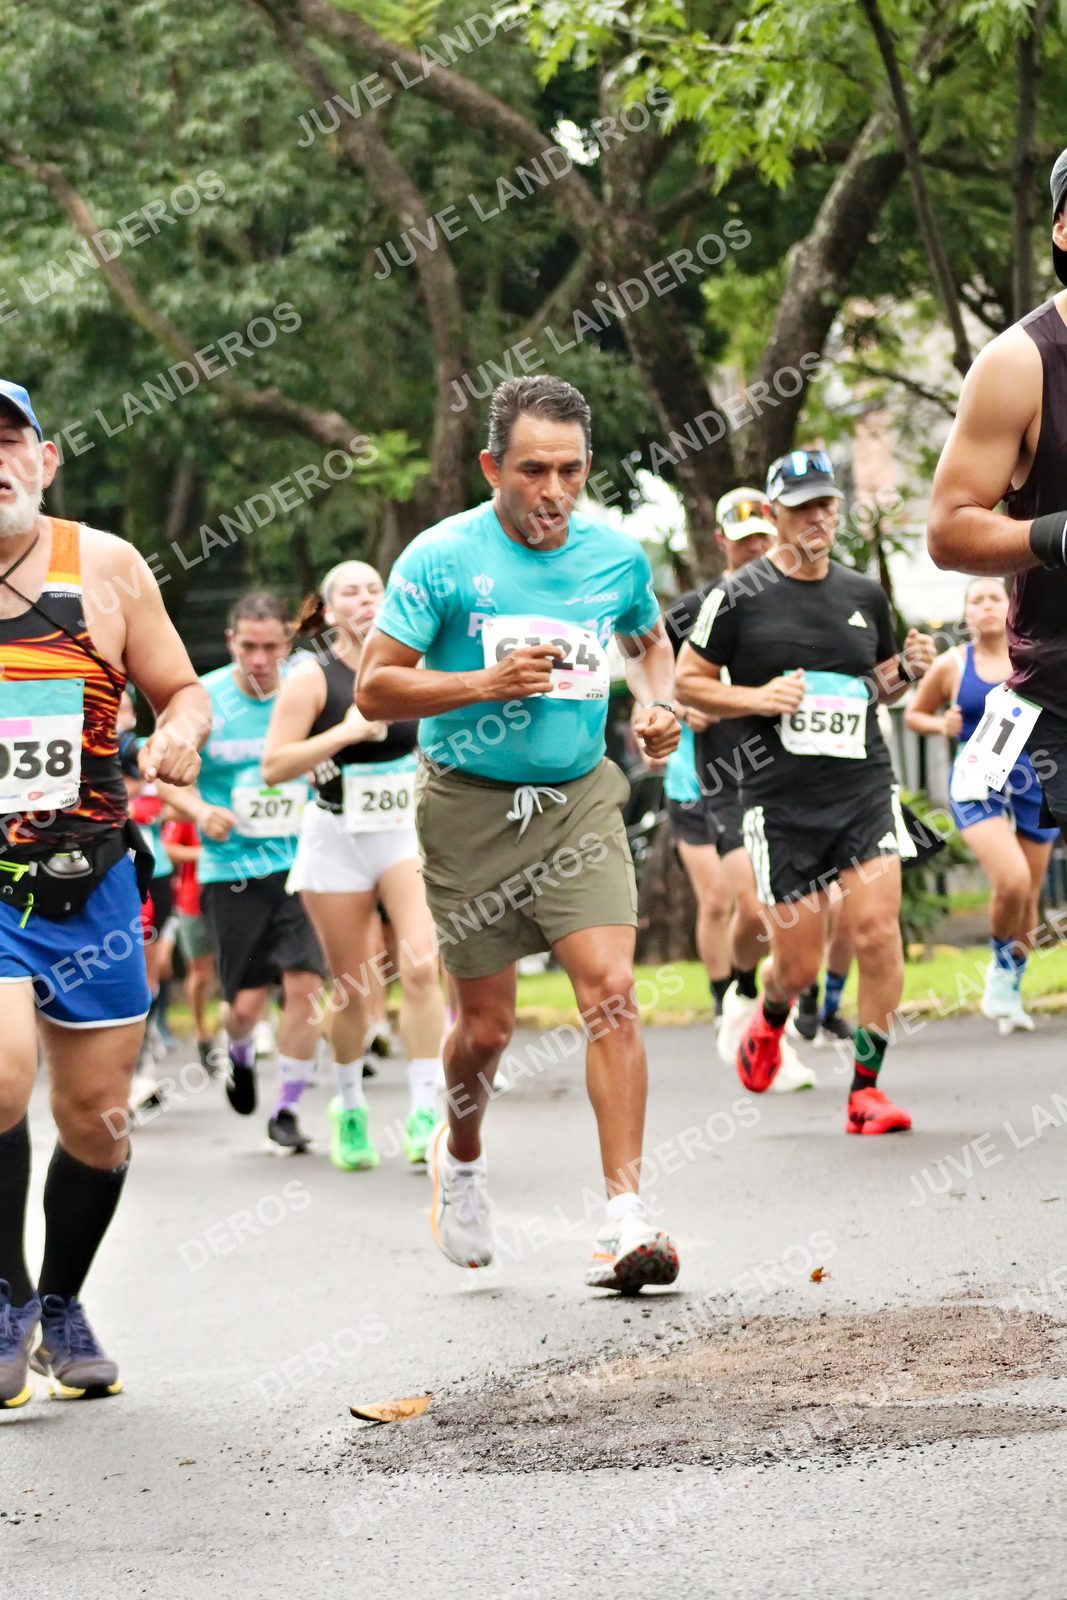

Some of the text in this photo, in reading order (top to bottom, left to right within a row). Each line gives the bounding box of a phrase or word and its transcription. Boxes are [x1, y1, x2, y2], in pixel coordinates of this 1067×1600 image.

[789, 710, 860, 736] 6587
[249, 799, 294, 818] 207
[361, 788, 409, 811] 280
